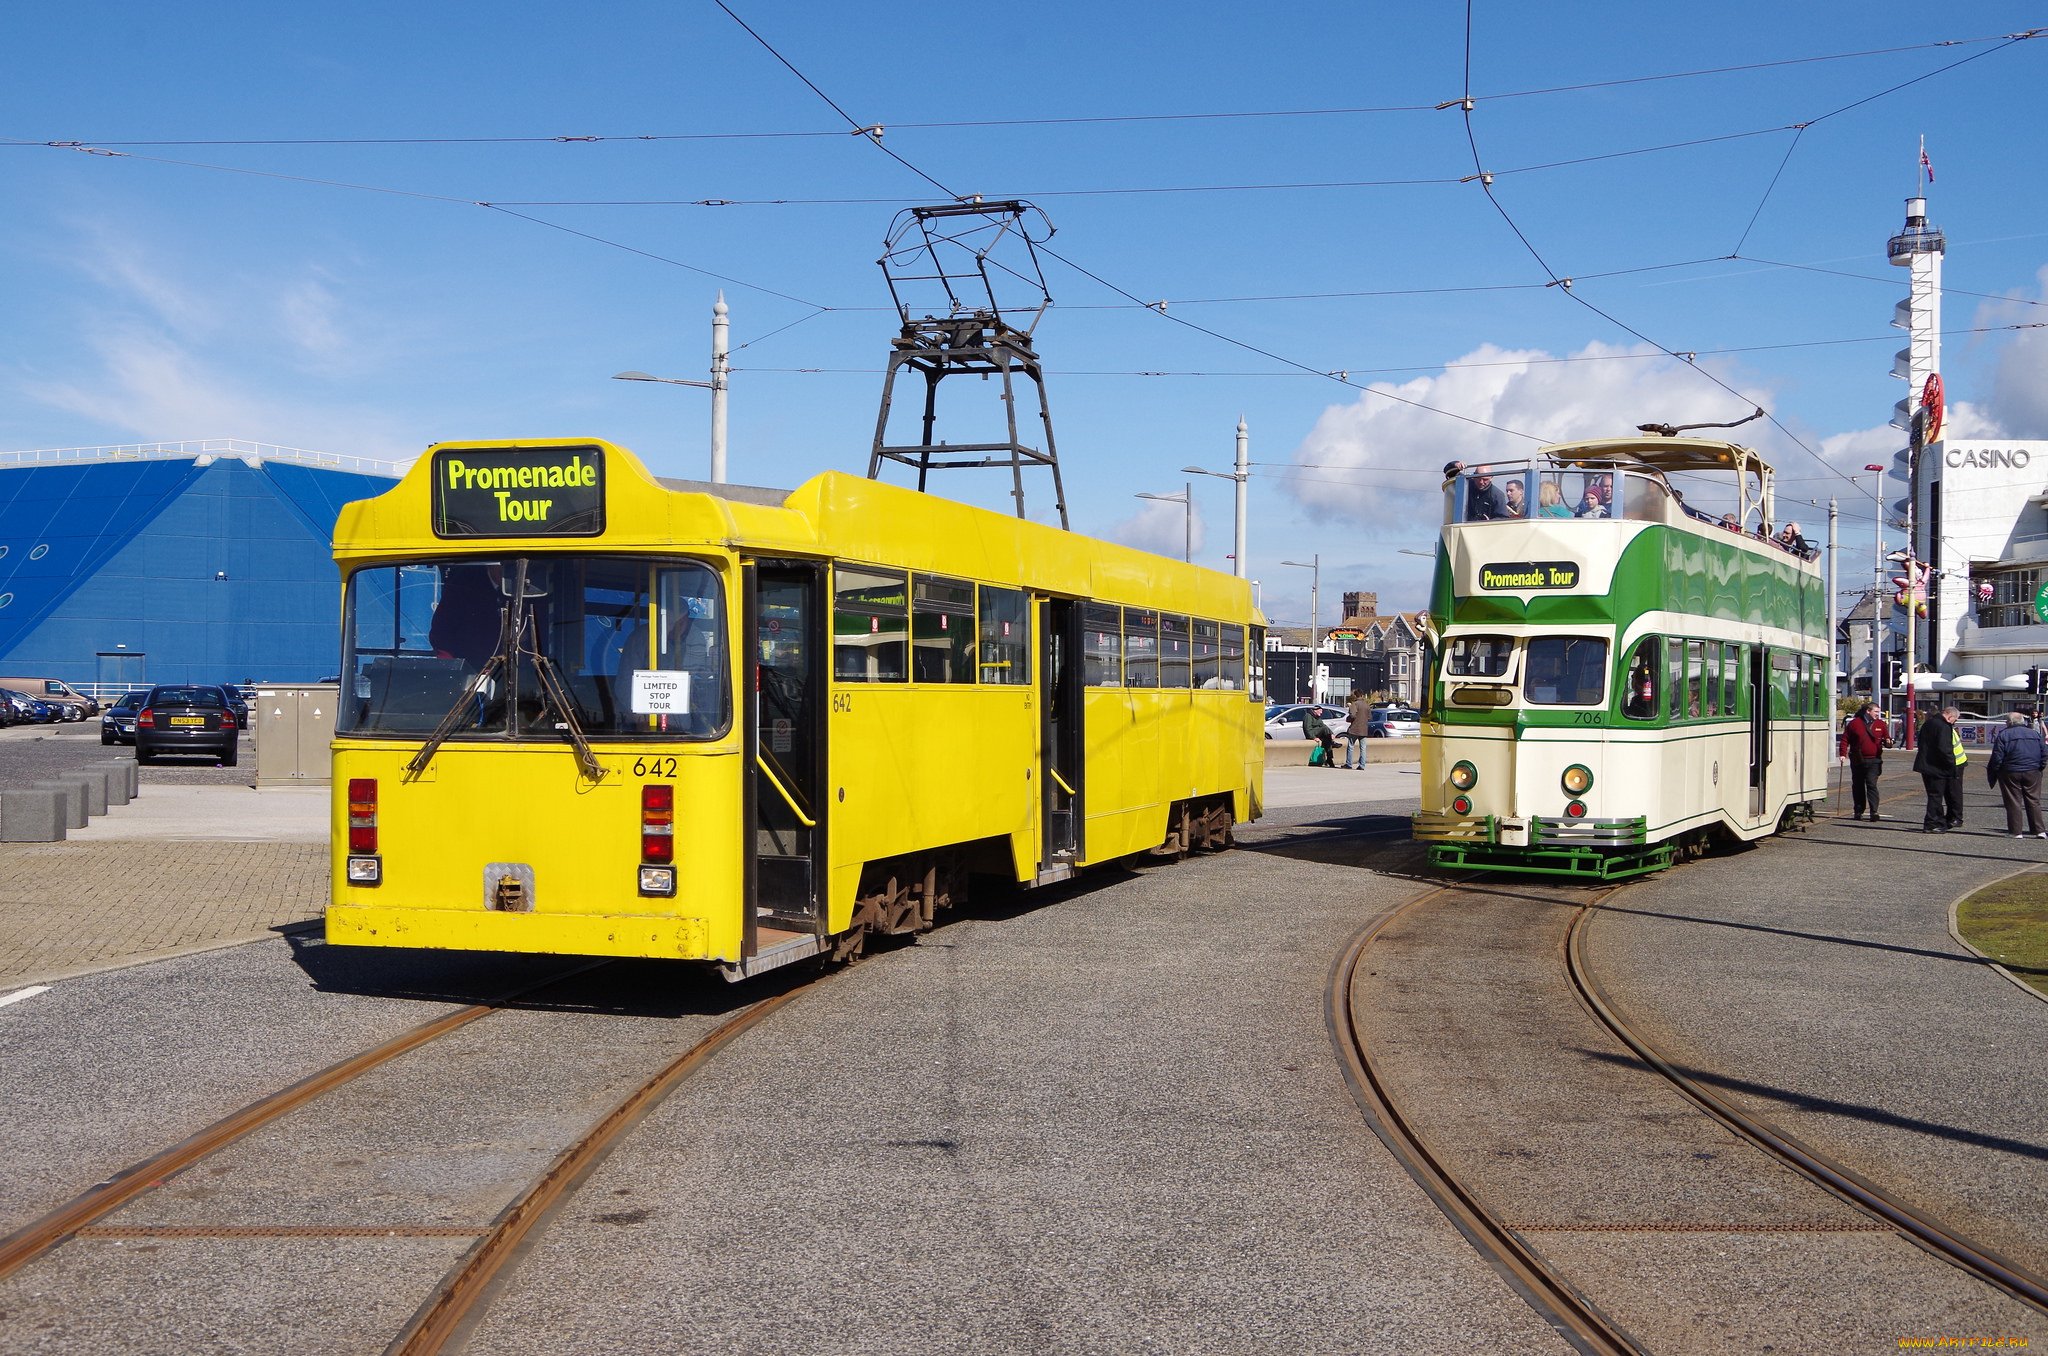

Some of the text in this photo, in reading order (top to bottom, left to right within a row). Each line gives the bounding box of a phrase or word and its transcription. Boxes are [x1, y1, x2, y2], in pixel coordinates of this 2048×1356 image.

[1946, 449, 2030, 469] CASINO
[448, 456, 596, 489] Promenade
[494, 491, 552, 522] Tour
[1484, 567, 1574, 587] Promenade Tour
[643, 682, 678, 690] LIMITED
[649, 692, 671, 700] STOP
[833, 693, 851, 712] 642
[648, 702, 671, 710] TOUR
[1574, 711, 1602, 725] 706
[633, 756, 678, 778] 642
